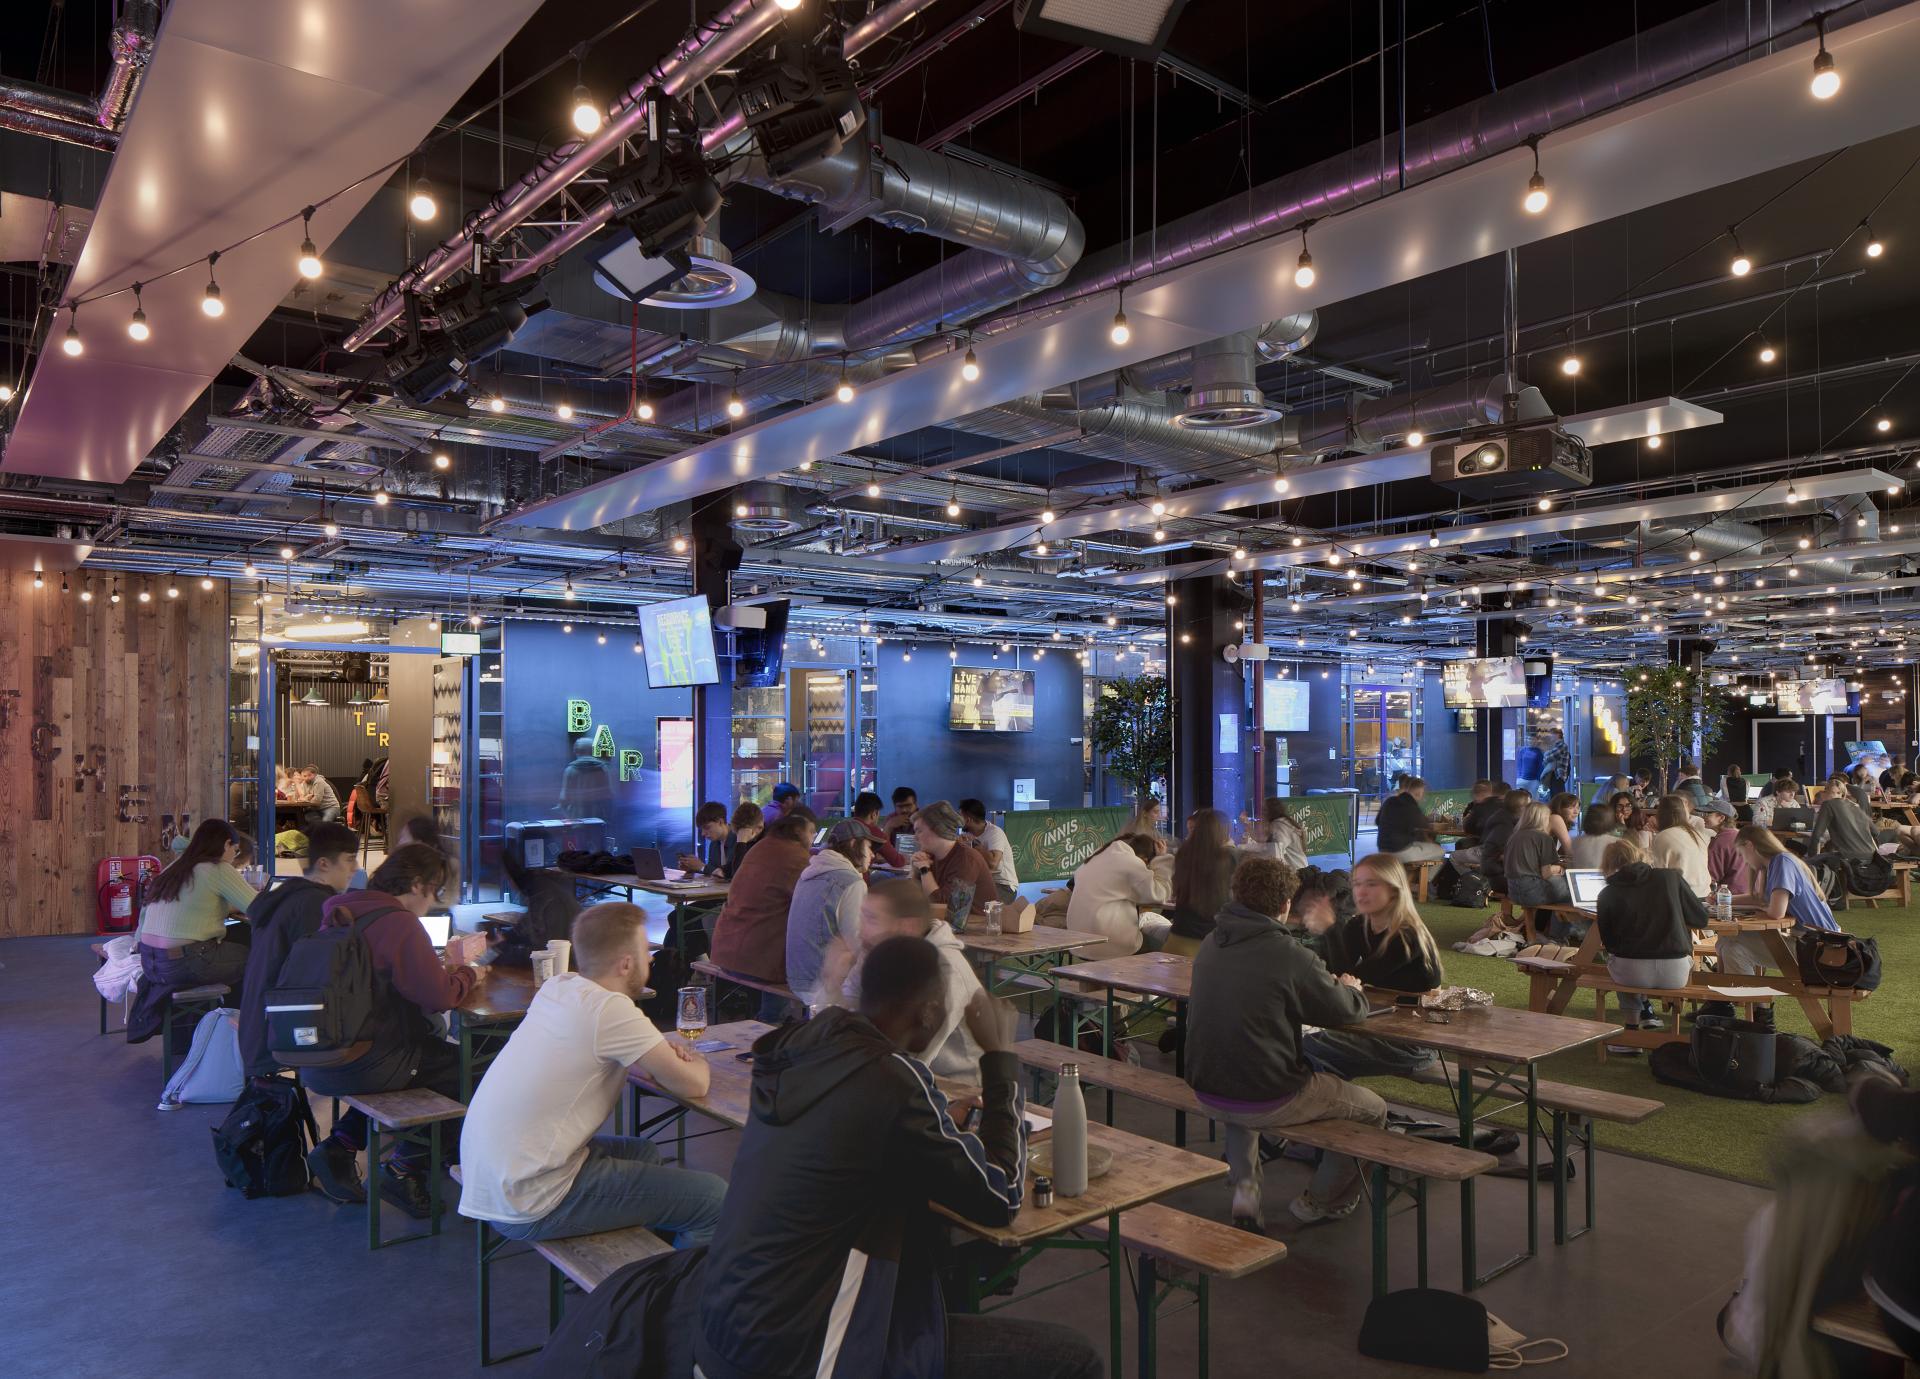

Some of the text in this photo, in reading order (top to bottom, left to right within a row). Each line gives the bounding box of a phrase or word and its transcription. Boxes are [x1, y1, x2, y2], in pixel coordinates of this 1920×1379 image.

[954, 673, 977, 683] LIVE
[953, 694, 982, 704] NIGHT
[568, 699, 644, 781] BAR
[1043, 819, 1078, 846] INNIS
[1065, 837, 1075, 853] &
[1061, 842, 1095, 870] GUNN
